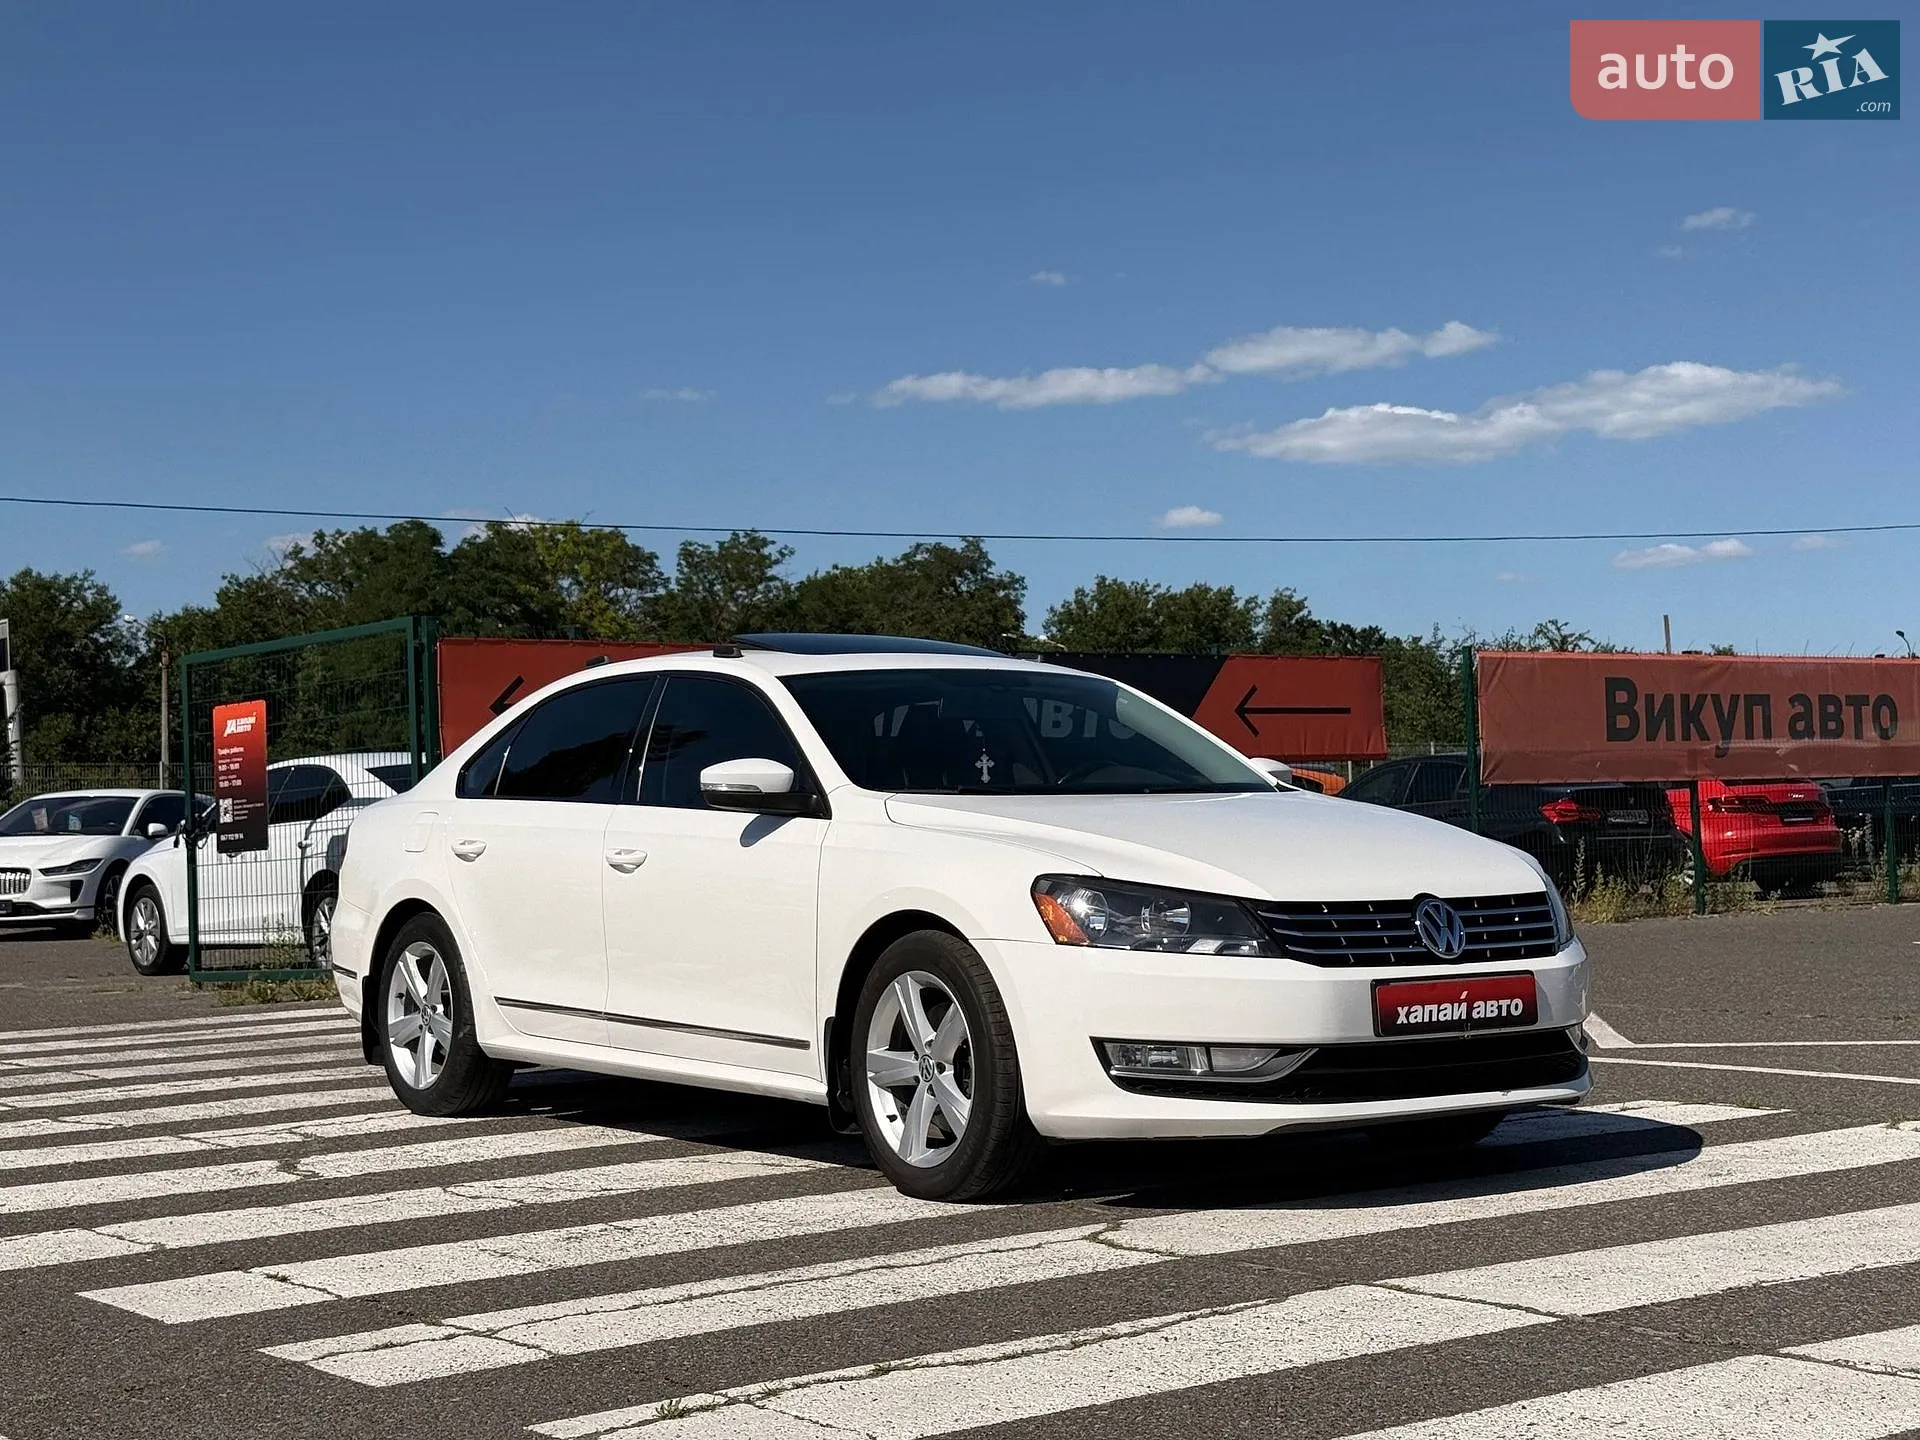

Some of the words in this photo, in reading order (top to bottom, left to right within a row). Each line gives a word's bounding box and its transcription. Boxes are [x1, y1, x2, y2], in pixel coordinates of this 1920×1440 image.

[1604, 677, 1773, 758] Викуп
[1787, 693, 1898, 741] авто
[1471, 998, 1524, 1019] авто
